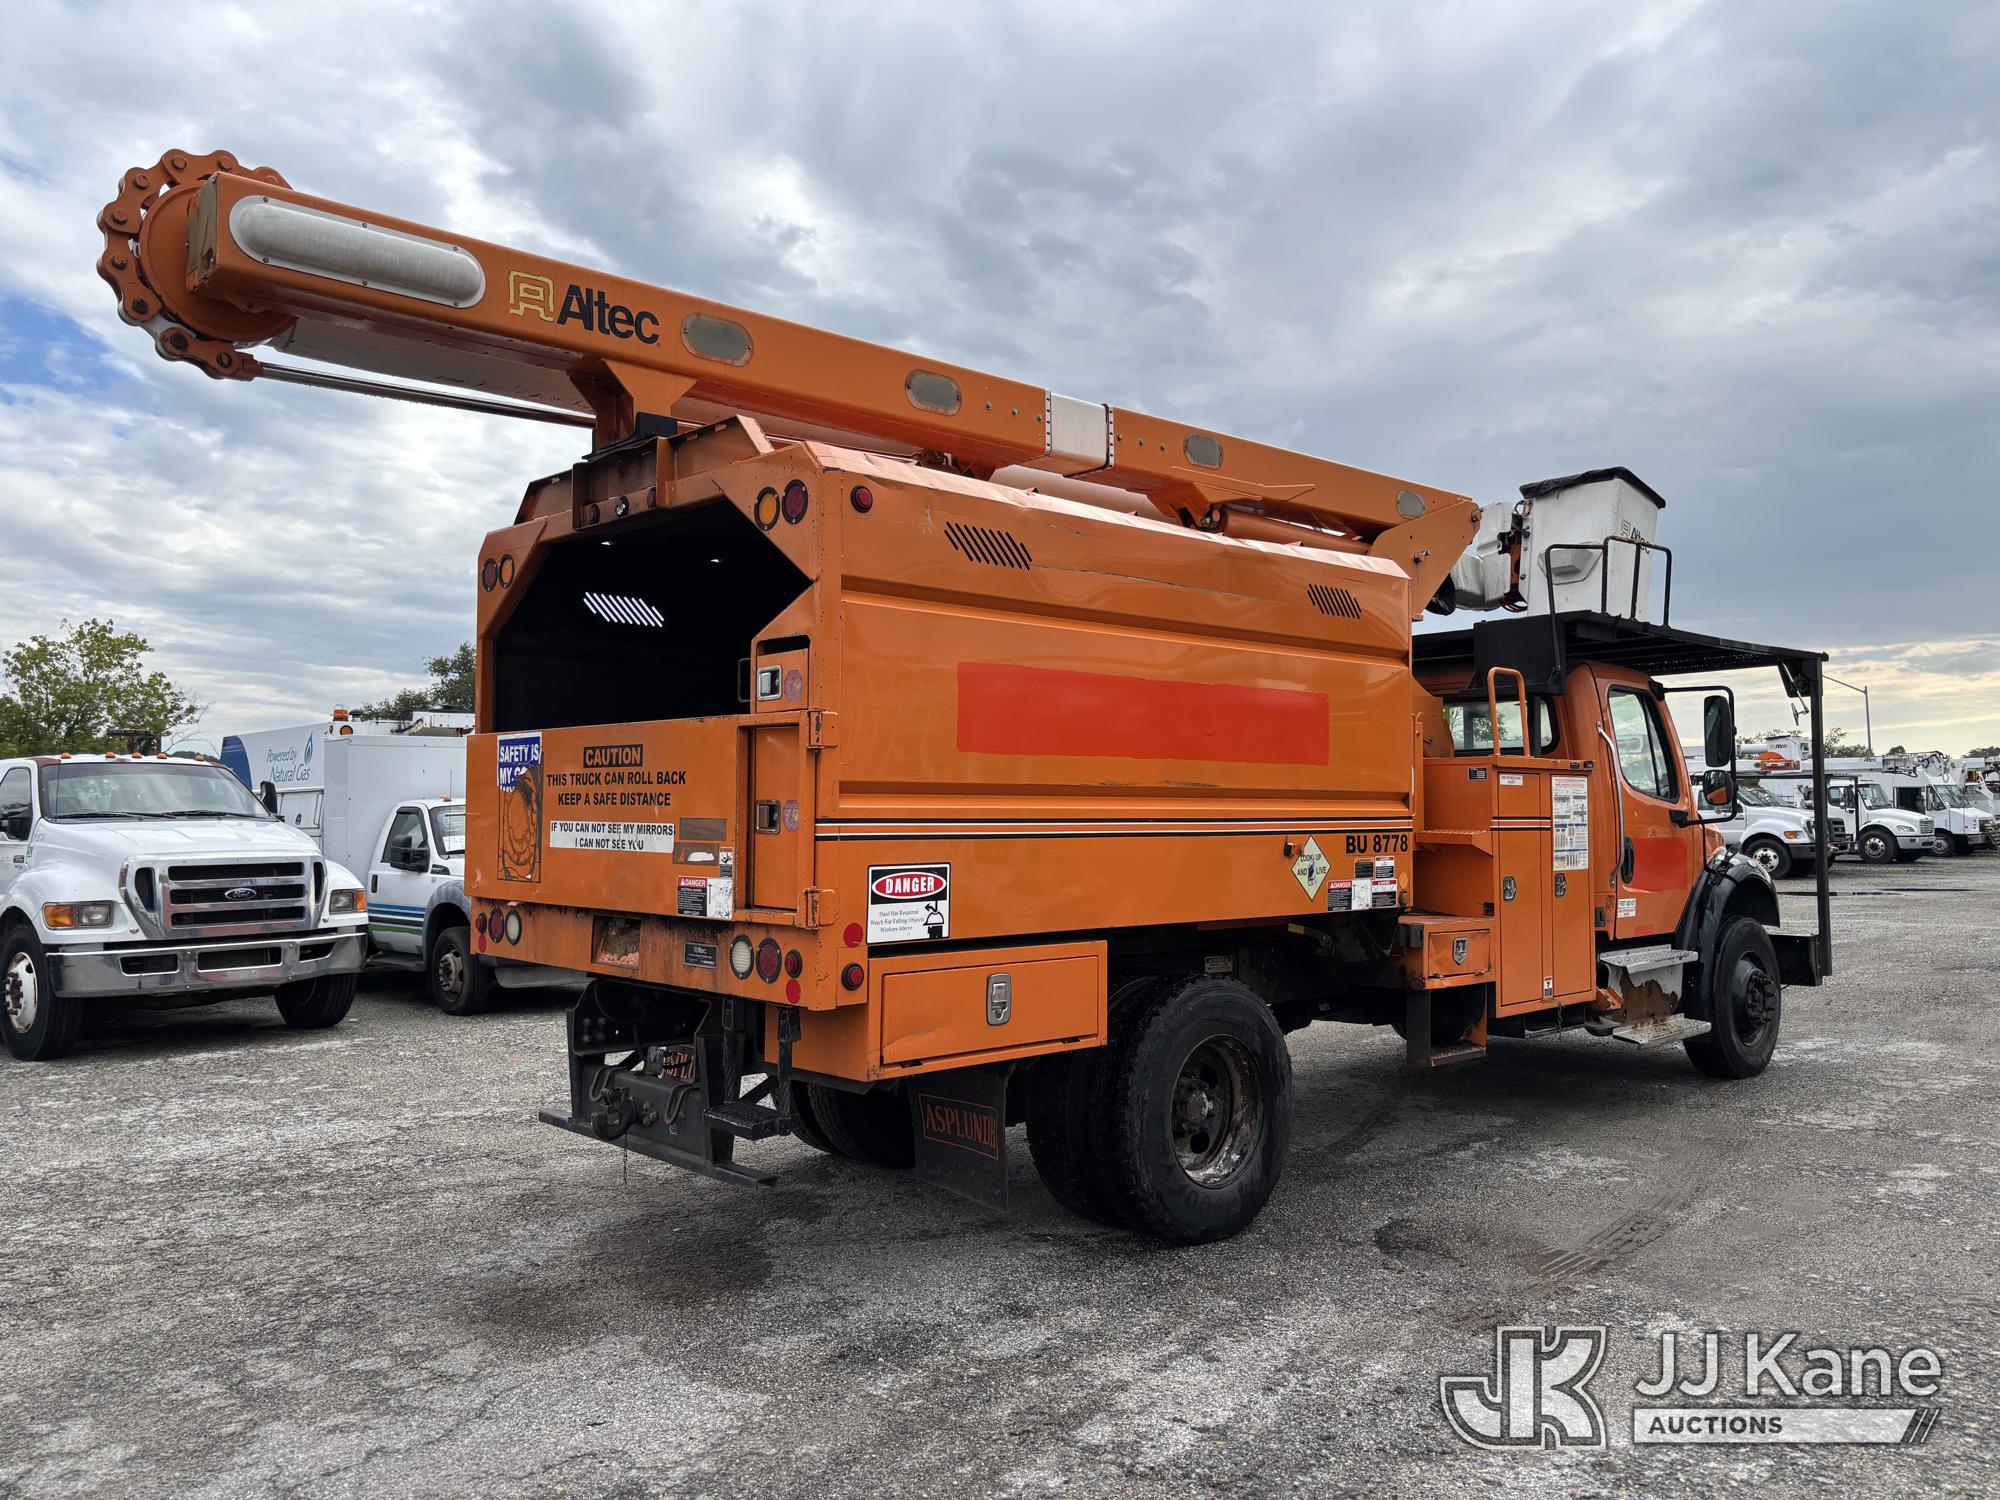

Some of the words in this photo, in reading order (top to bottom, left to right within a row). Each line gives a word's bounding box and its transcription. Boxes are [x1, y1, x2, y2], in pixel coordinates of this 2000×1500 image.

[557, 284, 659, 344] Altec
[266, 746, 290, 763] Powered
[500, 745, 529, 763] SAFETY
[531, 744, 539, 761] IS
[585, 747, 641, 766] CAUTION
[270, 764, 297, 783] Natural
[296, 763, 311, 781] Gas
[500, 767, 513, 784] MY
[547, 774, 567, 786] THIS
[570, 772, 601, 786] TRUCK
[604, 772, 625, 785] CAN
[627, 771, 654, 785] ROLL
[656, 770, 687, 785] BACK
[558, 793, 582, 806] KEEP
[584, 793, 590, 805] A
[593, 793, 617, 805] SAFE
[620, 792, 671, 806] DISTANCE
[551, 822, 558, 832] IF
[559, 823, 573, 832] YOU
[575, 823, 589, 833] CAN
[591, 823, 606, 834] NOT
[608, 824, 622, 834] SEE
[623, 824, 635, 835] MY
[637, 824, 674, 836] MIRRORS
[580, 838, 594, 848] CAN
[595, 838, 610, 849] NOT
[612, 839, 626, 849] SEE
[628, 840, 644, 850] YOU
[1346, 834, 1367, 854] BU
[1373, 834, 1408, 853] 8778
[1297, 868, 1307, 876] AND
[1316, 867, 1326, 875] LIVE
[684, 879, 706, 887] DANGER
[885, 877, 934, 894] DANGER
[926, 1104, 996, 1149] ASPLUNDH
